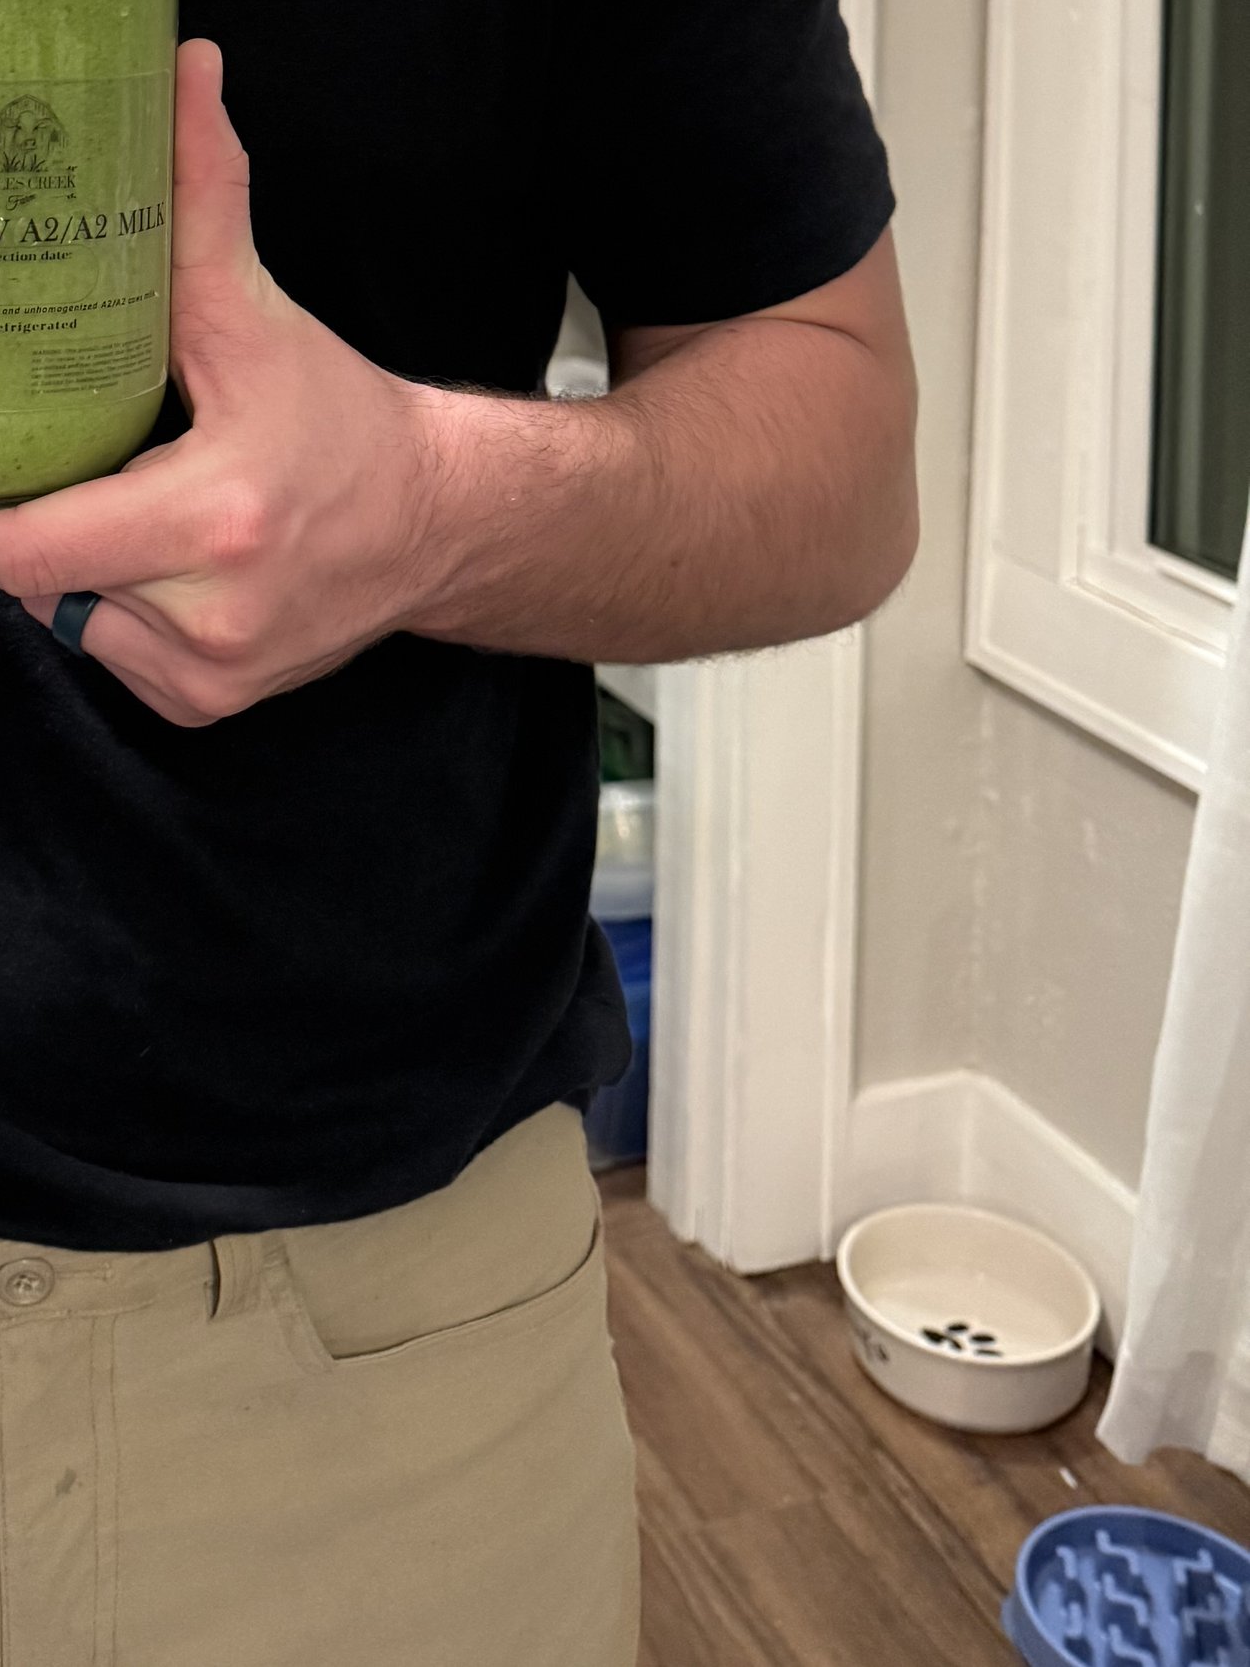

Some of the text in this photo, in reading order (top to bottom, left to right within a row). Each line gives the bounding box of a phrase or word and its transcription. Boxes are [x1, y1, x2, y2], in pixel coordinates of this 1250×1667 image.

[28, 175, 76, 189] CREEK
[20, 213, 108, 244] A2/A2
[118, 201, 165, 237] MILK
[40, 250, 73, 261] date:
[2, 306, 21, 315] and
[24, 302, 98, 315] unhomogenized
[101, 297, 126, 309] A2/A2
